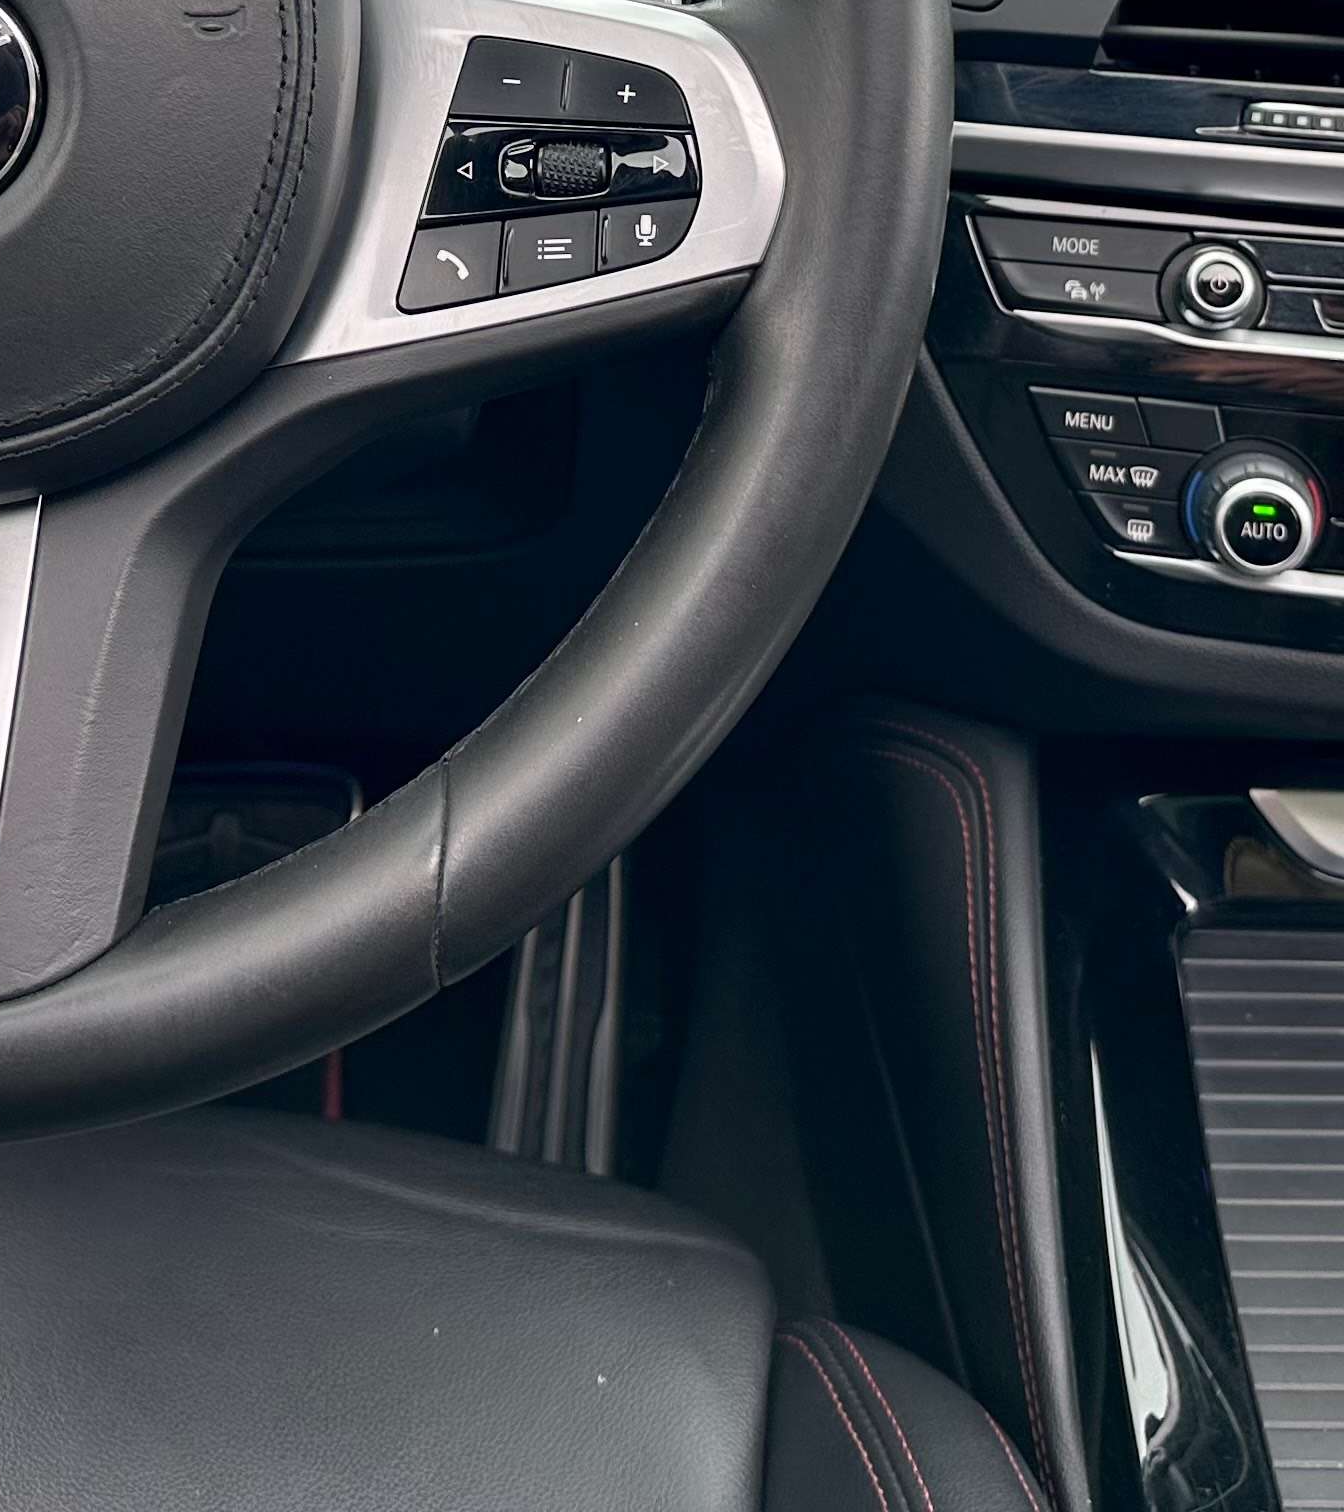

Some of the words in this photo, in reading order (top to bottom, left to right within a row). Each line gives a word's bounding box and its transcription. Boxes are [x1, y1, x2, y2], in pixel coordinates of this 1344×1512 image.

[1052, 236, 1100, 256] MODE
[1064, 411, 1114, 430] MENU
[1089, 464, 1126, 484] MAX
[1240, 521, 1288, 541] AUTO
